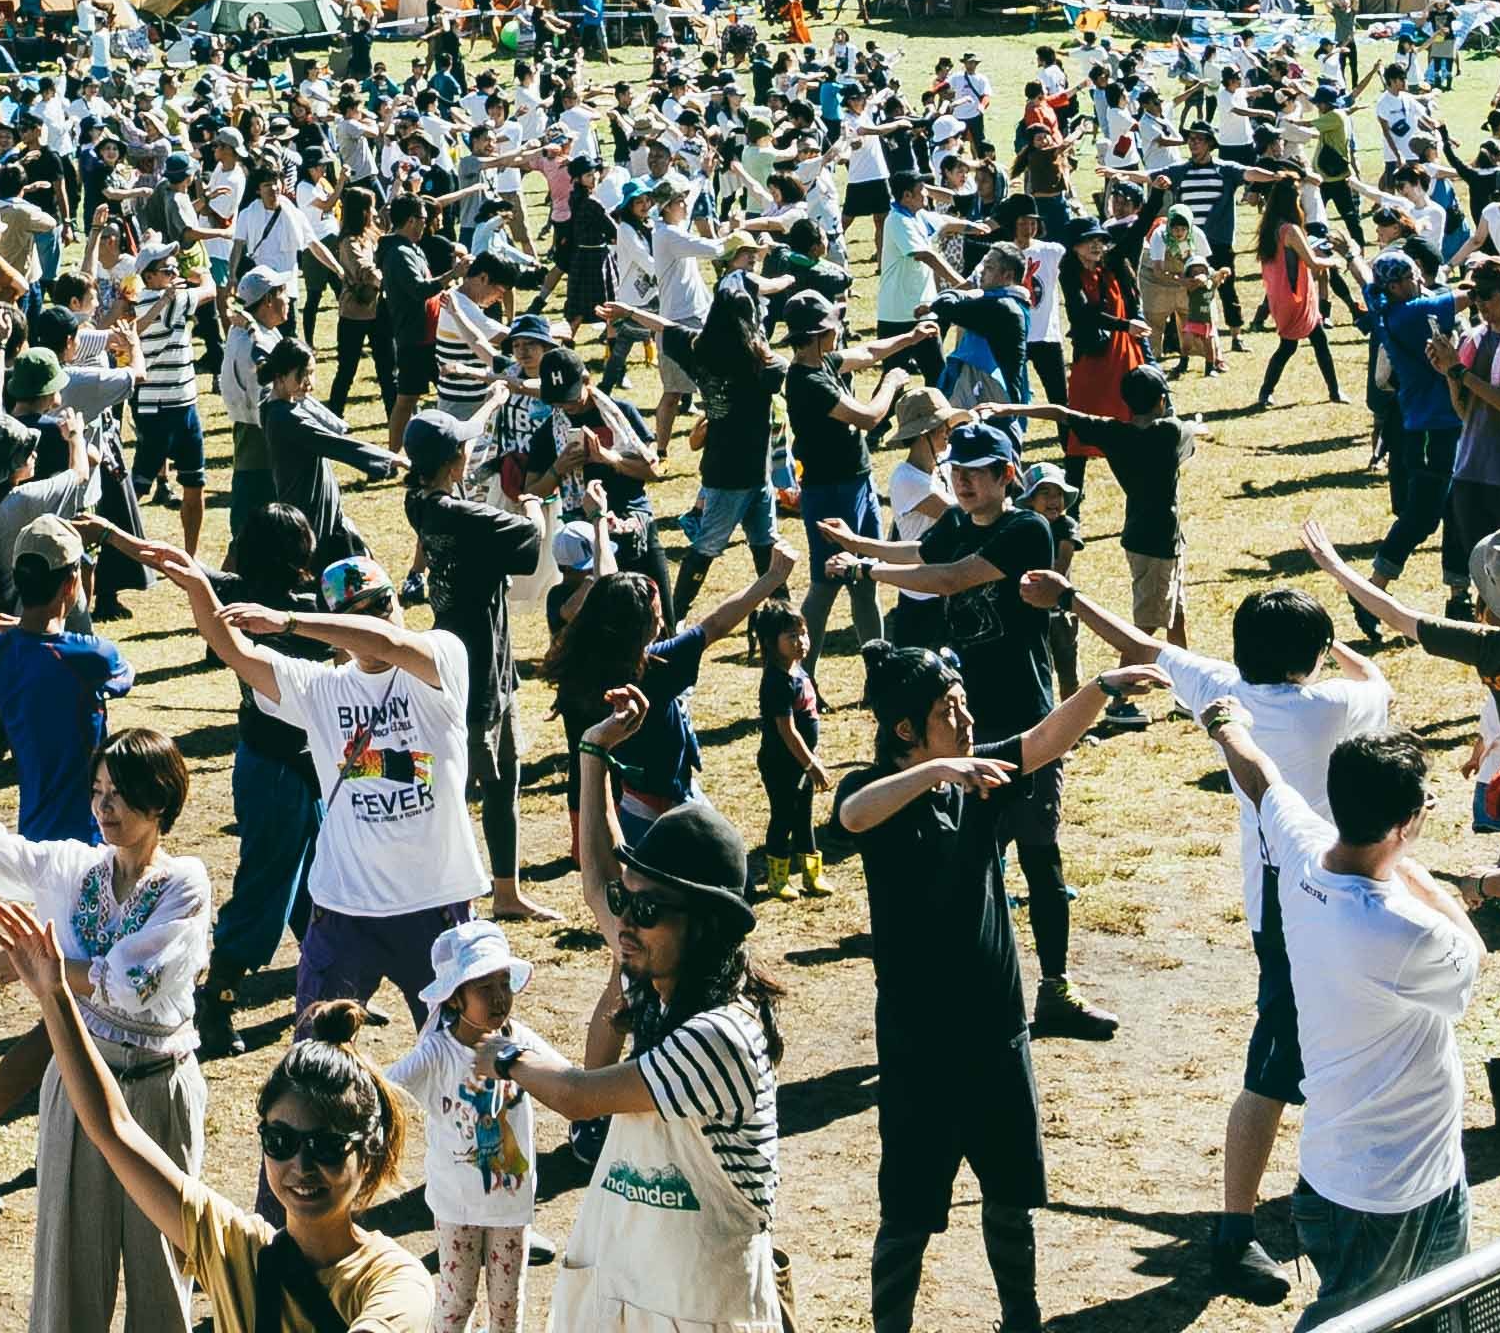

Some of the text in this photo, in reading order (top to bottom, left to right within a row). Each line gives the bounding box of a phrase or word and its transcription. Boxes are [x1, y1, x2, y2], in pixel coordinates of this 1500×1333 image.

[551, 370, 564, 386] H
[338, 693, 409, 729] BUNNY
[351, 783, 434, 816] FEVER
